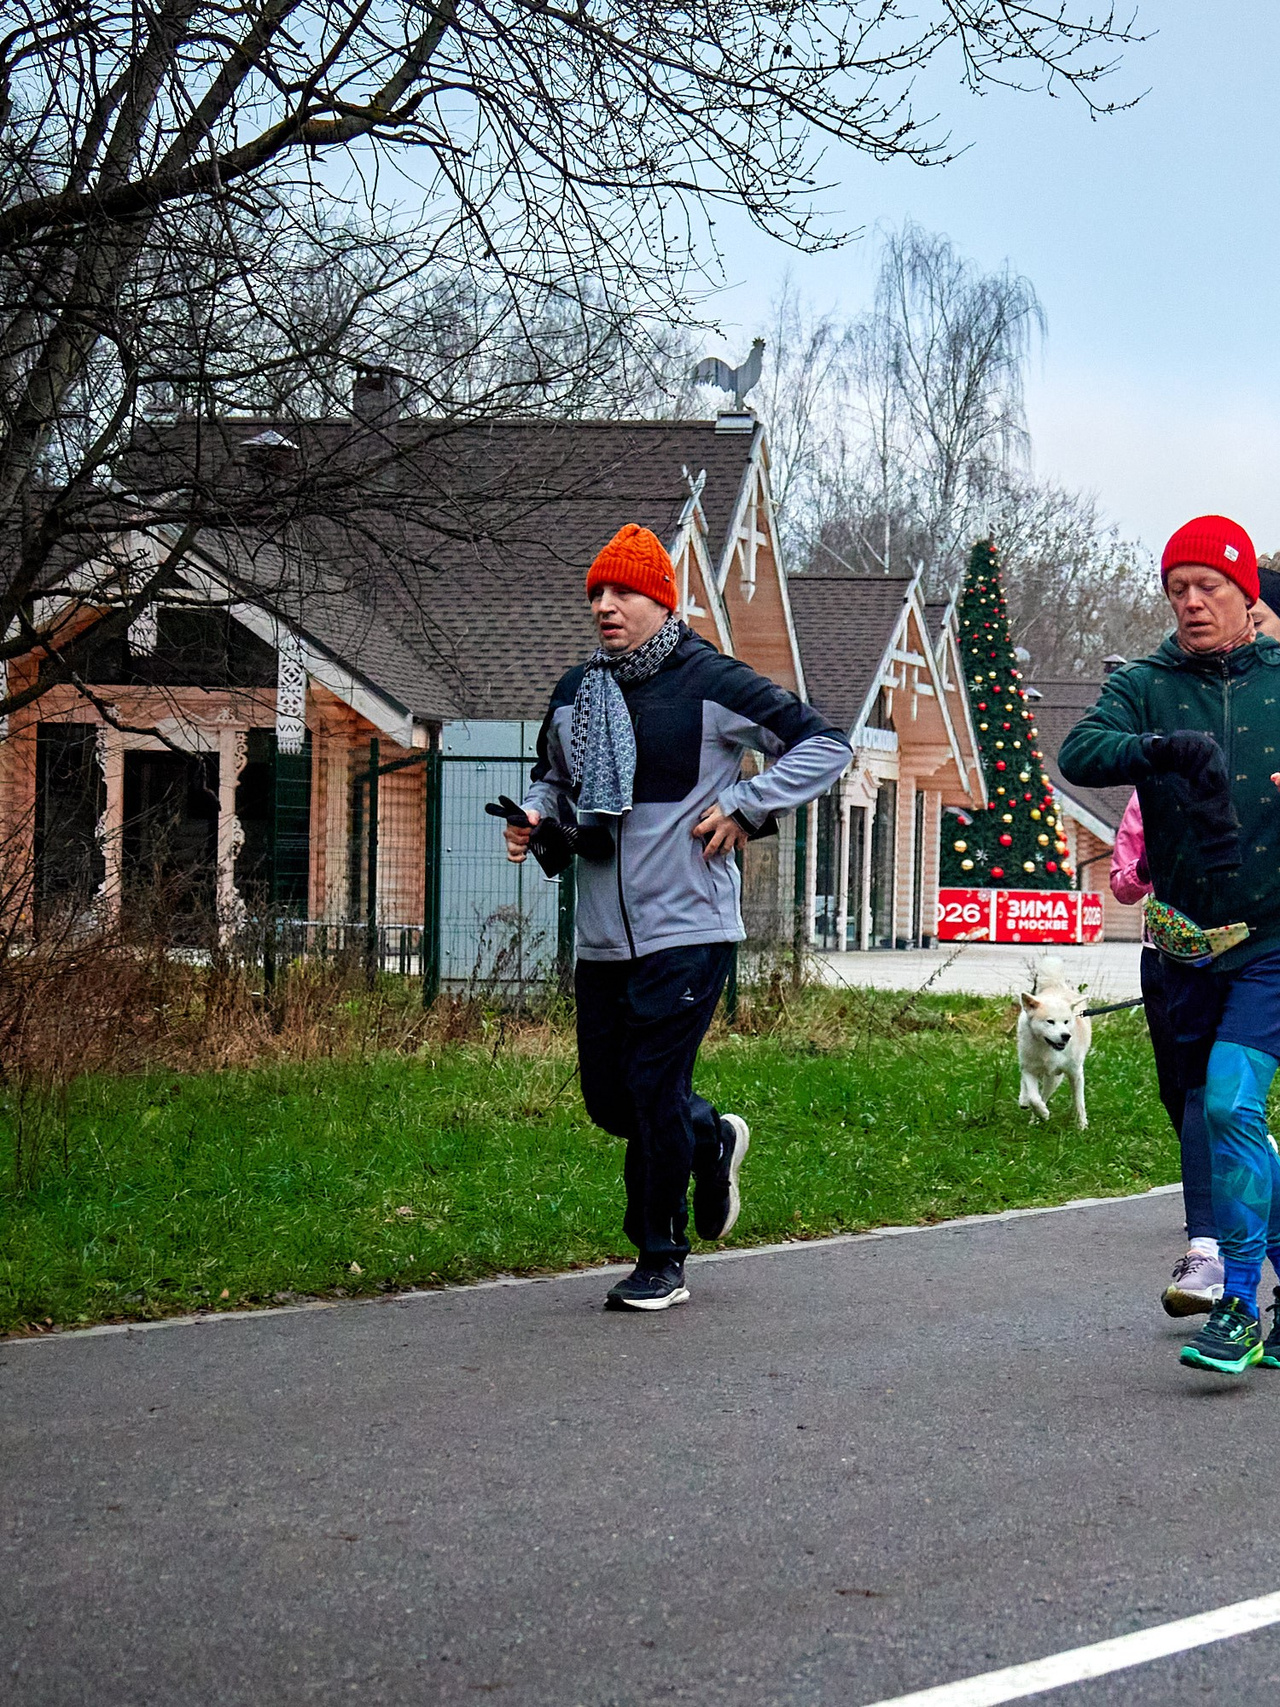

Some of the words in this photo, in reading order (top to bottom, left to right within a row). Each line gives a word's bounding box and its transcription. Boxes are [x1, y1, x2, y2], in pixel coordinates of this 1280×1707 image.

[1007, 899, 1069, 918] ЗИМА
[1006, 919, 1016, 930] В
[1018, 919, 1069, 930] МОСКВЕ
